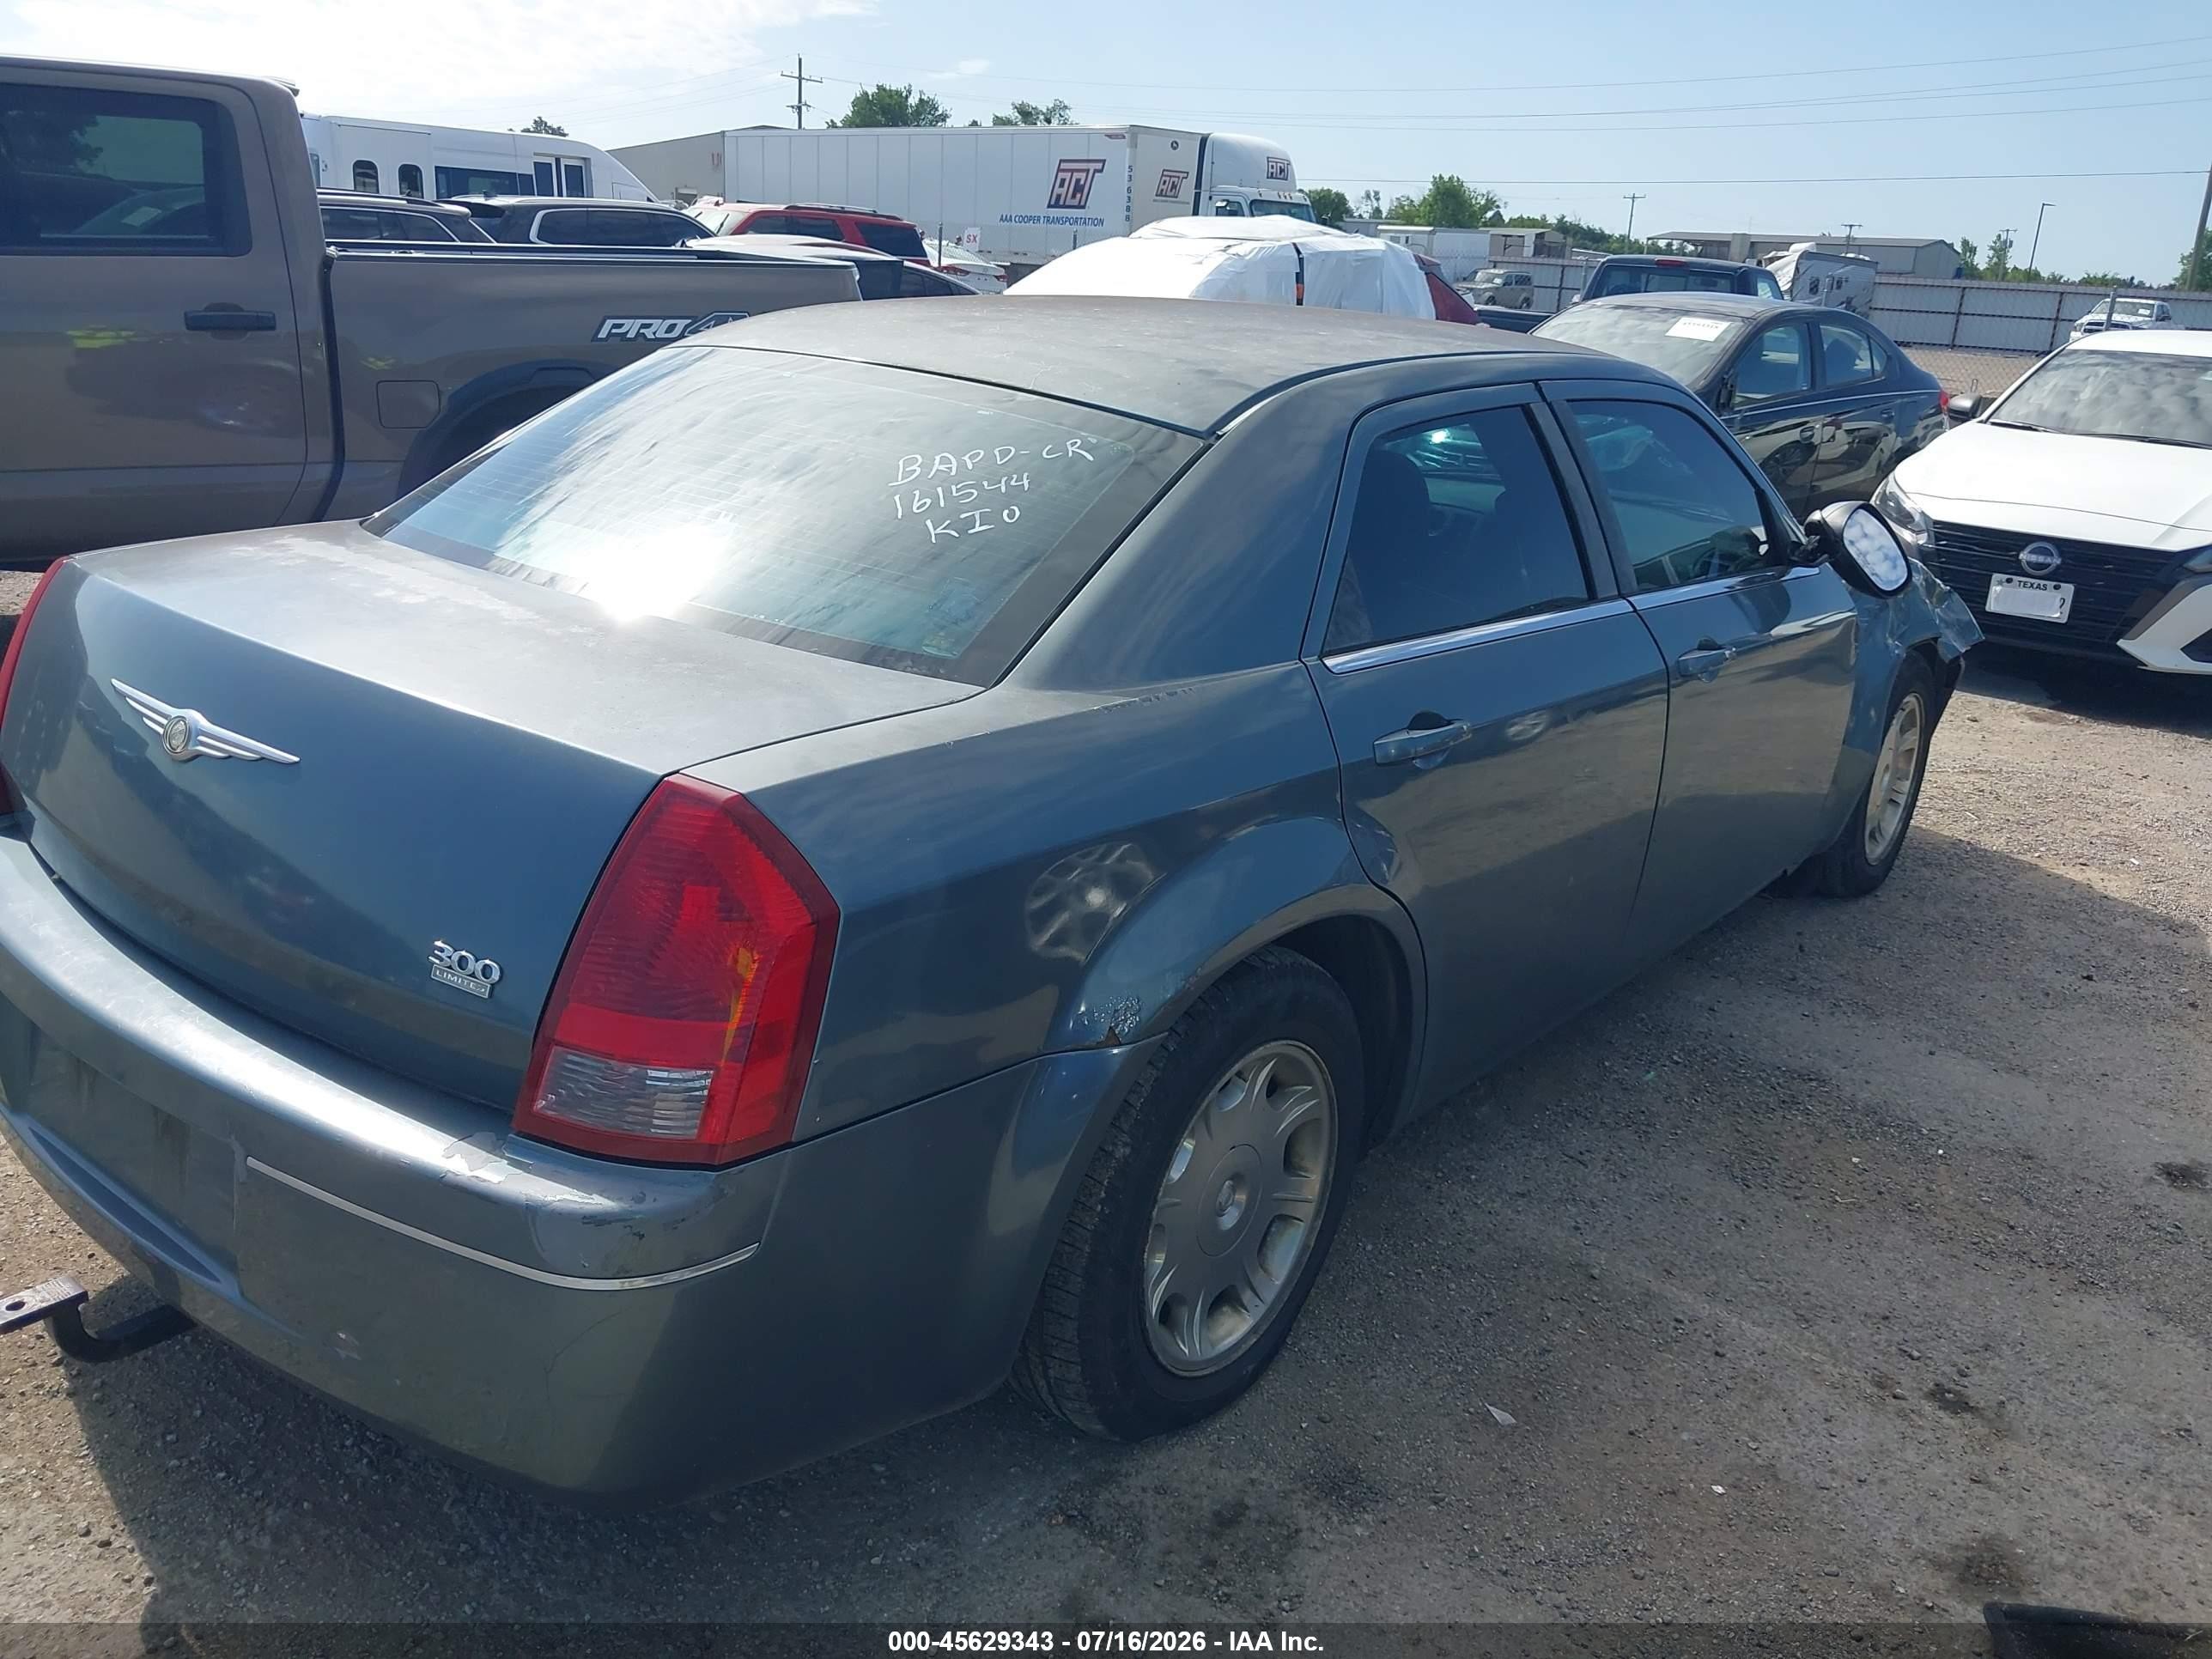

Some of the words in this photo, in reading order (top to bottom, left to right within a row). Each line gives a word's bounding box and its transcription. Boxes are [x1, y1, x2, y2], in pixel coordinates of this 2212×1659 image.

[1047, 159, 1106, 209] ACT
[1155, 168, 1189, 198] ACT
[999, 214, 1013, 223] AAA
[1013, 215, 1042, 225] COOPER
[1042, 216, 1105, 227] TRANSPORTATION
[966, 234, 977, 244] SX
[894, 472, 1030, 519] 161544
[2017, 580, 2048, 592] TEXAS
[428, 939, 501, 984] 300
[435, 969, 486, 994] LIMITED
